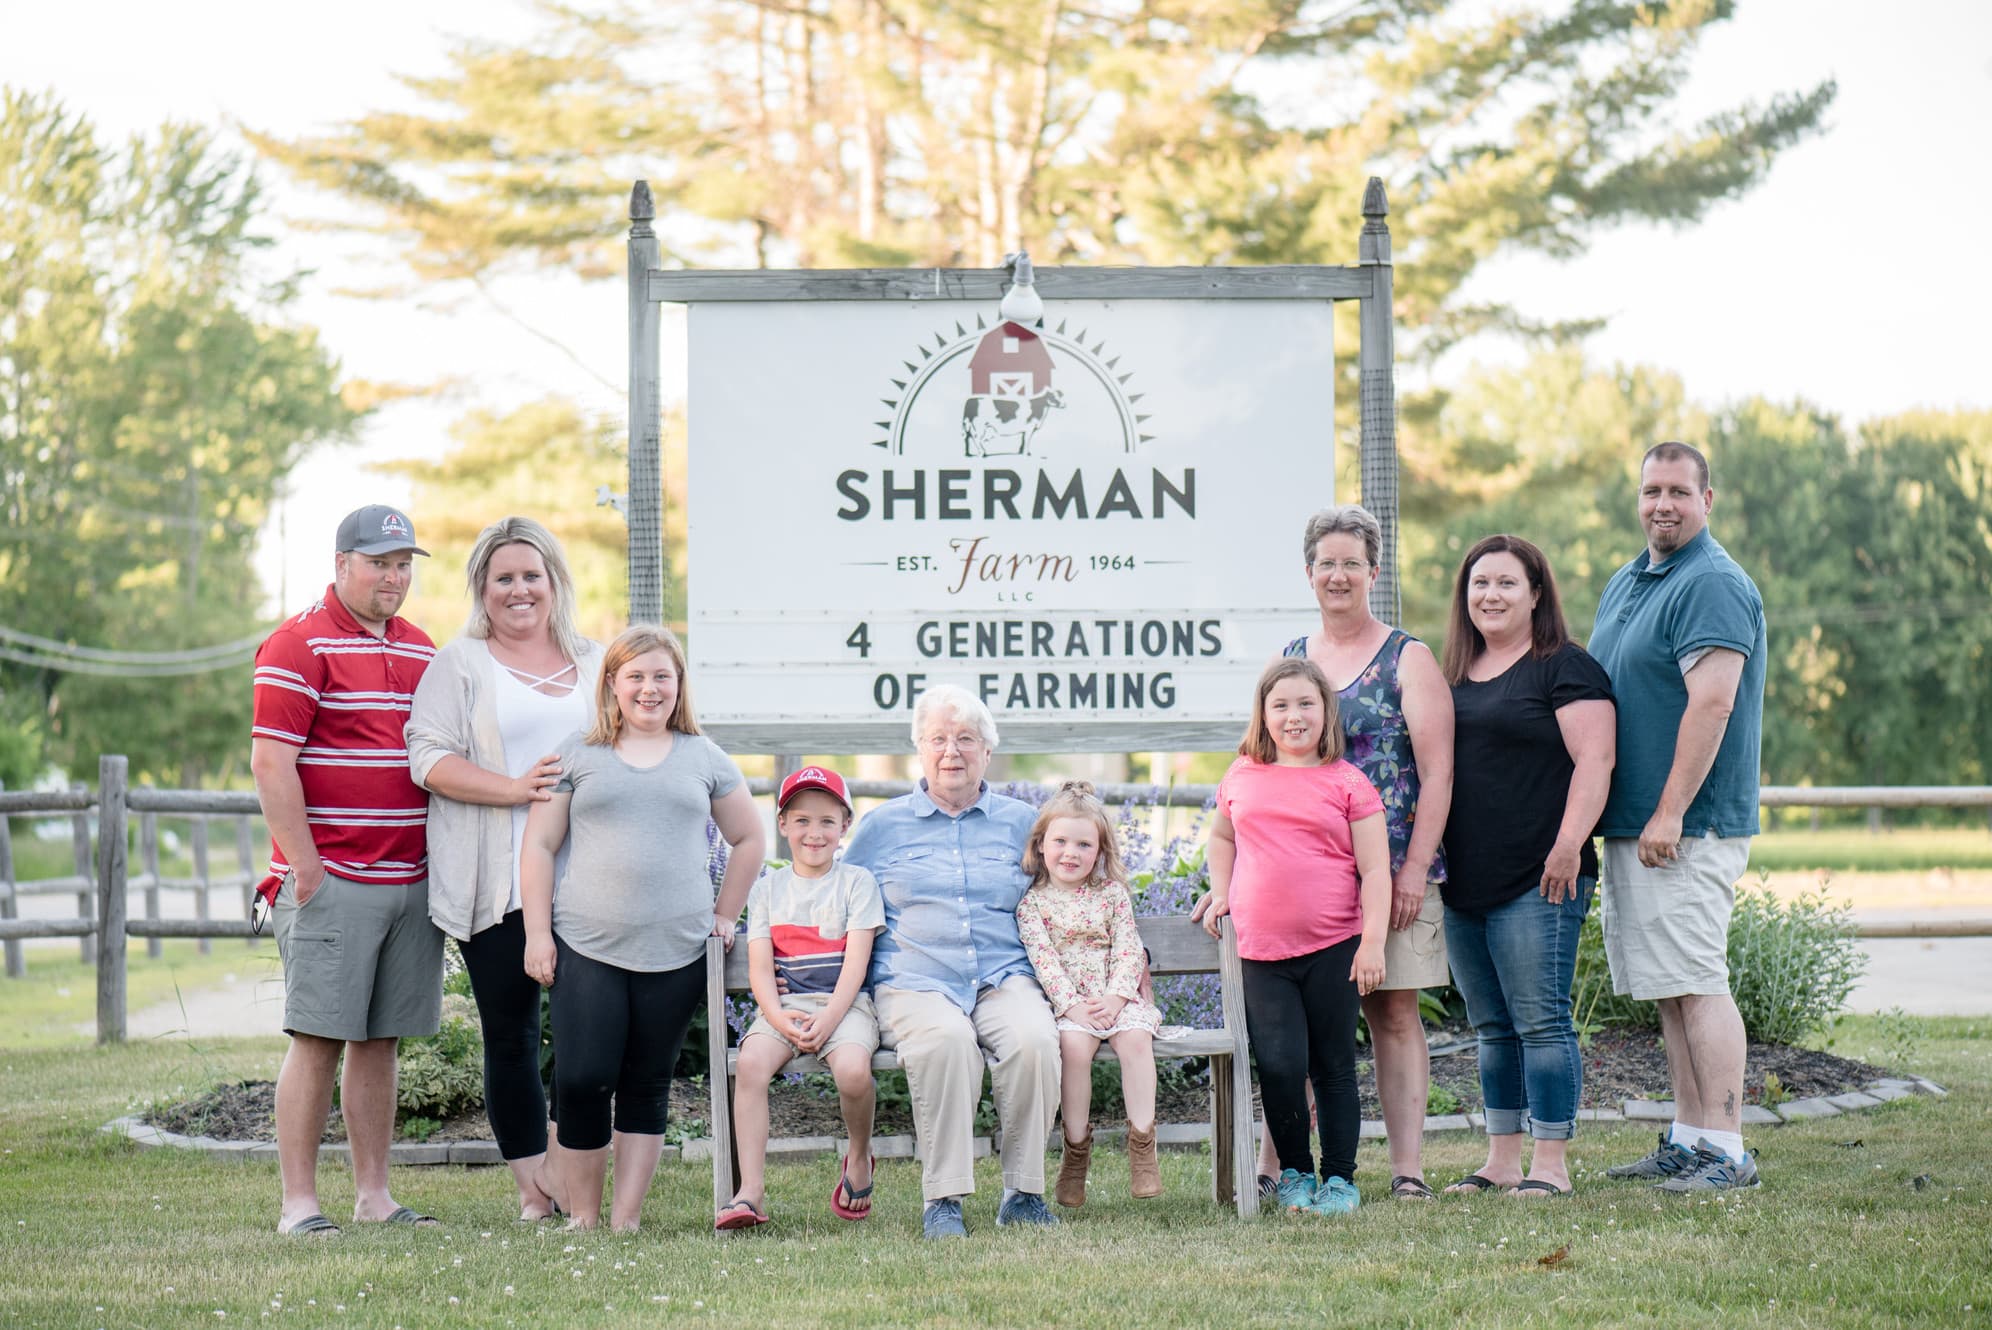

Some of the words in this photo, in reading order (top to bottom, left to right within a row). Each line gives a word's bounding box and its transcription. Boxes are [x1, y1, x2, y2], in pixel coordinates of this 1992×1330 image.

[837, 467, 1197, 521] SHERMAN
[897, 556, 938, 571] EST.
[947, 536, 1079, 594] Farm
[1090, 555, 1136, 570] 1964
[998, 591, 1033, 602] LLC
[846, 622, 872, 658] 4
[917, 620, 1222, 658] GENERATIONS
[873, 673, 926, 710] OF
[979, 672, 1176, 709] FARMING
